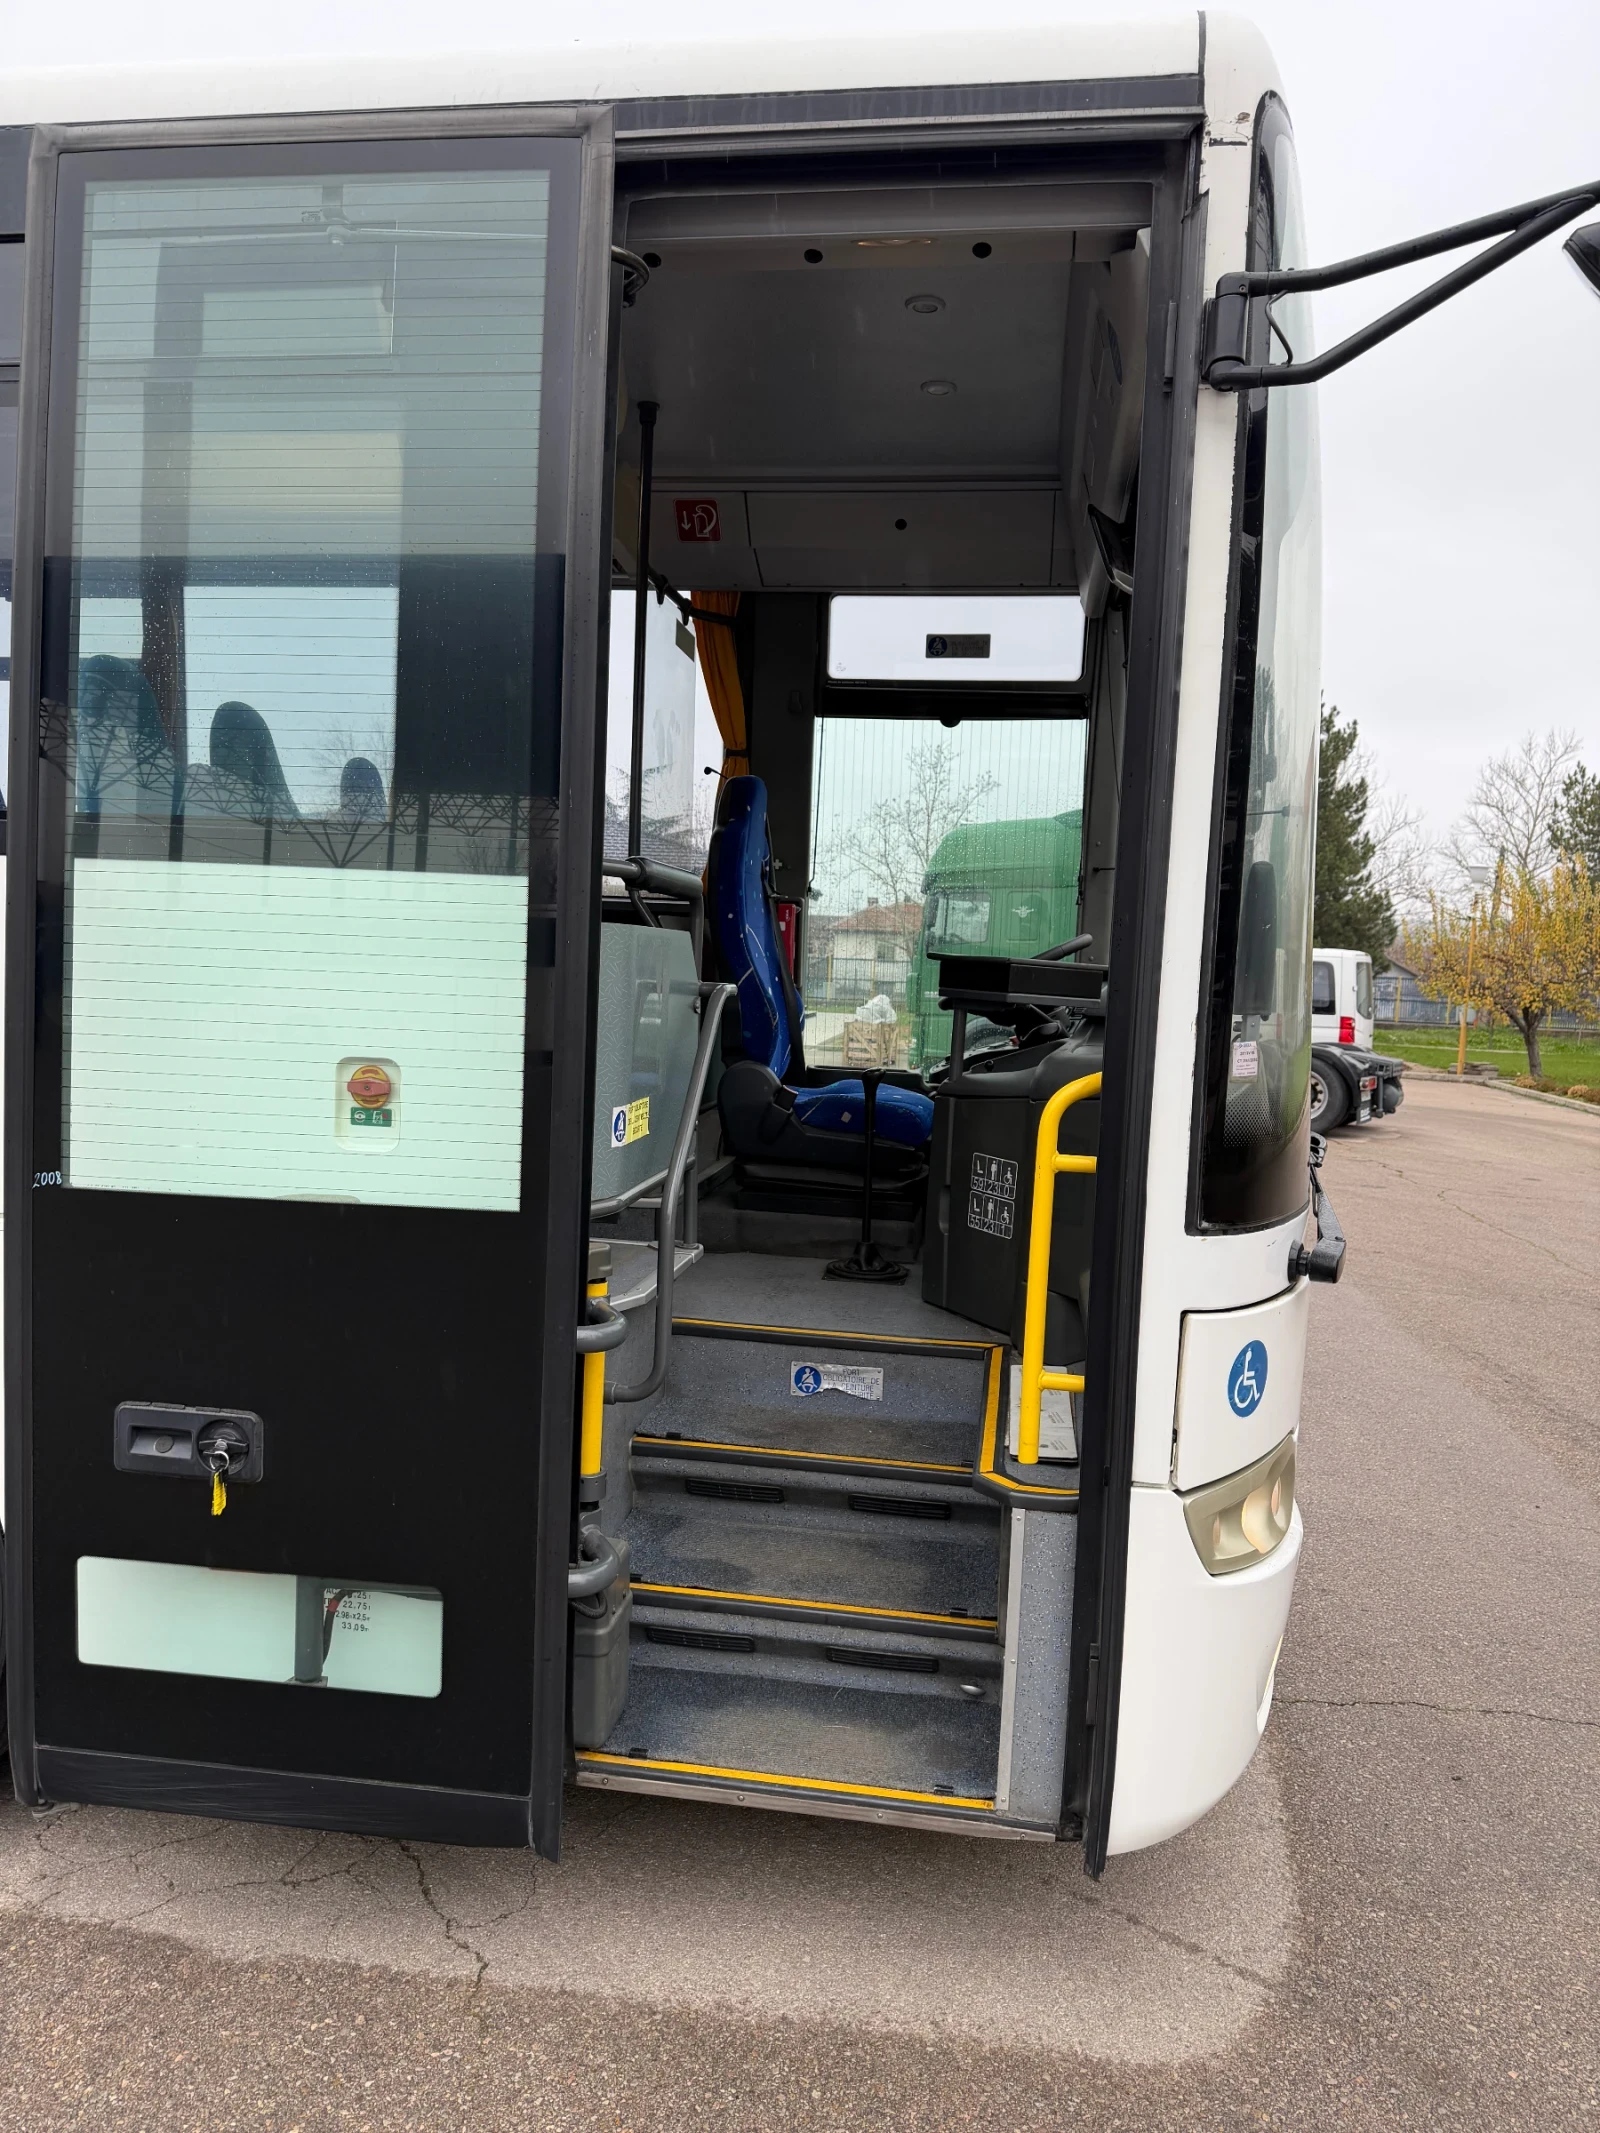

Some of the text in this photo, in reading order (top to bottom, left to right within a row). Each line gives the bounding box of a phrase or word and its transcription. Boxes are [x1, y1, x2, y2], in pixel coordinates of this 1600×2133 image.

[32, 1171, 62, 1189] 2008
[972, 1177, 984, 1190] 59
[987, 1181, 999, 1195] 23
[969, 1214, 981, 1228] 55
[983, 1220, 995, 1233] 23
[842, 1368, 860, 1376] PORT
[871, 1377, 881, 1386] DE
